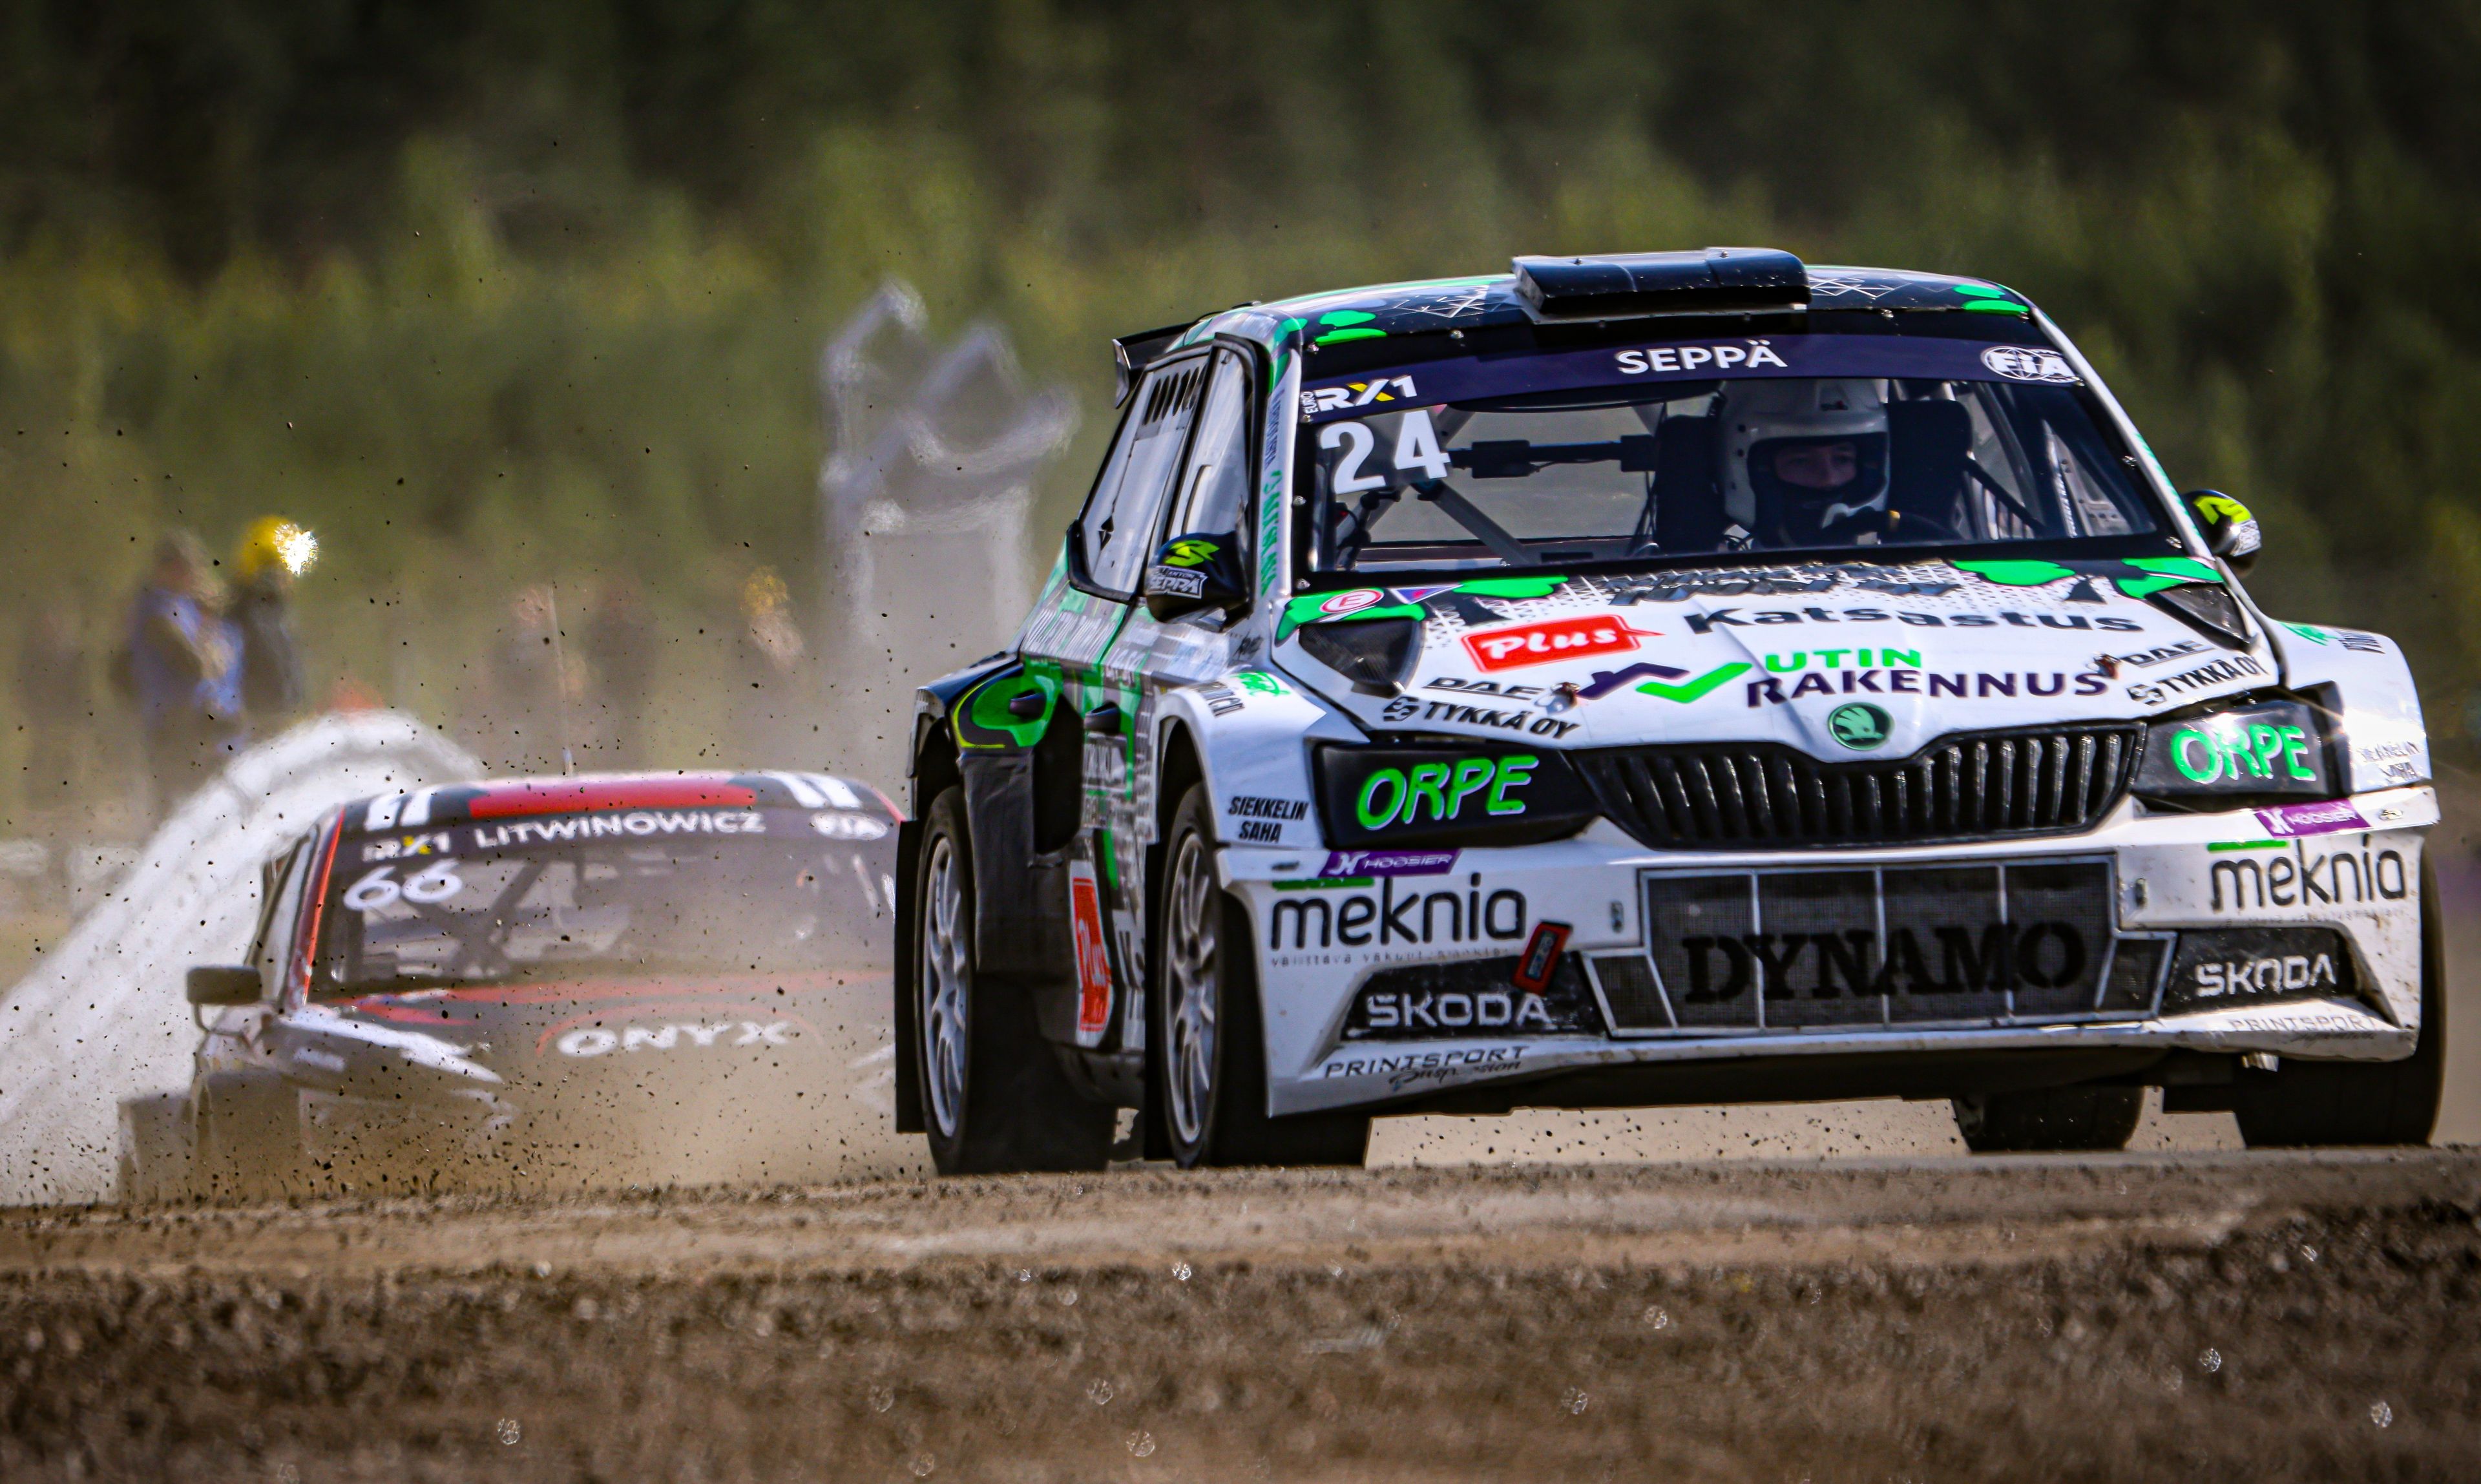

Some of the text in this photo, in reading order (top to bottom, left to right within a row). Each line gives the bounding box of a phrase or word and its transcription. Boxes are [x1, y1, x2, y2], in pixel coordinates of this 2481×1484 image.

[1617, 339, 1787, 375] SEPPÄ
[1300, 392, 1319, 414] EURO
[1314, 375, 1417, 412] RX1
[1320, 409, 1450, 494] 24
[1480, 606, 2144, 660] Plus Katsastus
[1765, 647, 1921, 673] UTIN
[2155, 658, 2247, 694] TYKKÄ
[2234, 655, 2270, 676] OY
[1747, 669, 2109, 708] RAKENNUS
[1423, 700, 1534, 731] TYKKÄ
[1529, 717, 1582, 740] OY
[2170, 723, 2318, 784] ORPE
[1229, 795, 1308, 820] SIEKKELIN
[1357, 755, 1540, 831] ORPE
[474, 811, 766, 849] LITWINOWICZ
[1239, 820, 1282, 843] SAHA
[342, 857, 464, 911] 66
[2210, 833, 2405, 910] meknia
[1270, 872, 1527, 950] meknia
[1682, 921, 2086, 1003] DYNAMO
[555, 1020, 793, 1058] ONYX
[1325, 1045, 1530, 1078] PRINTSPORT
